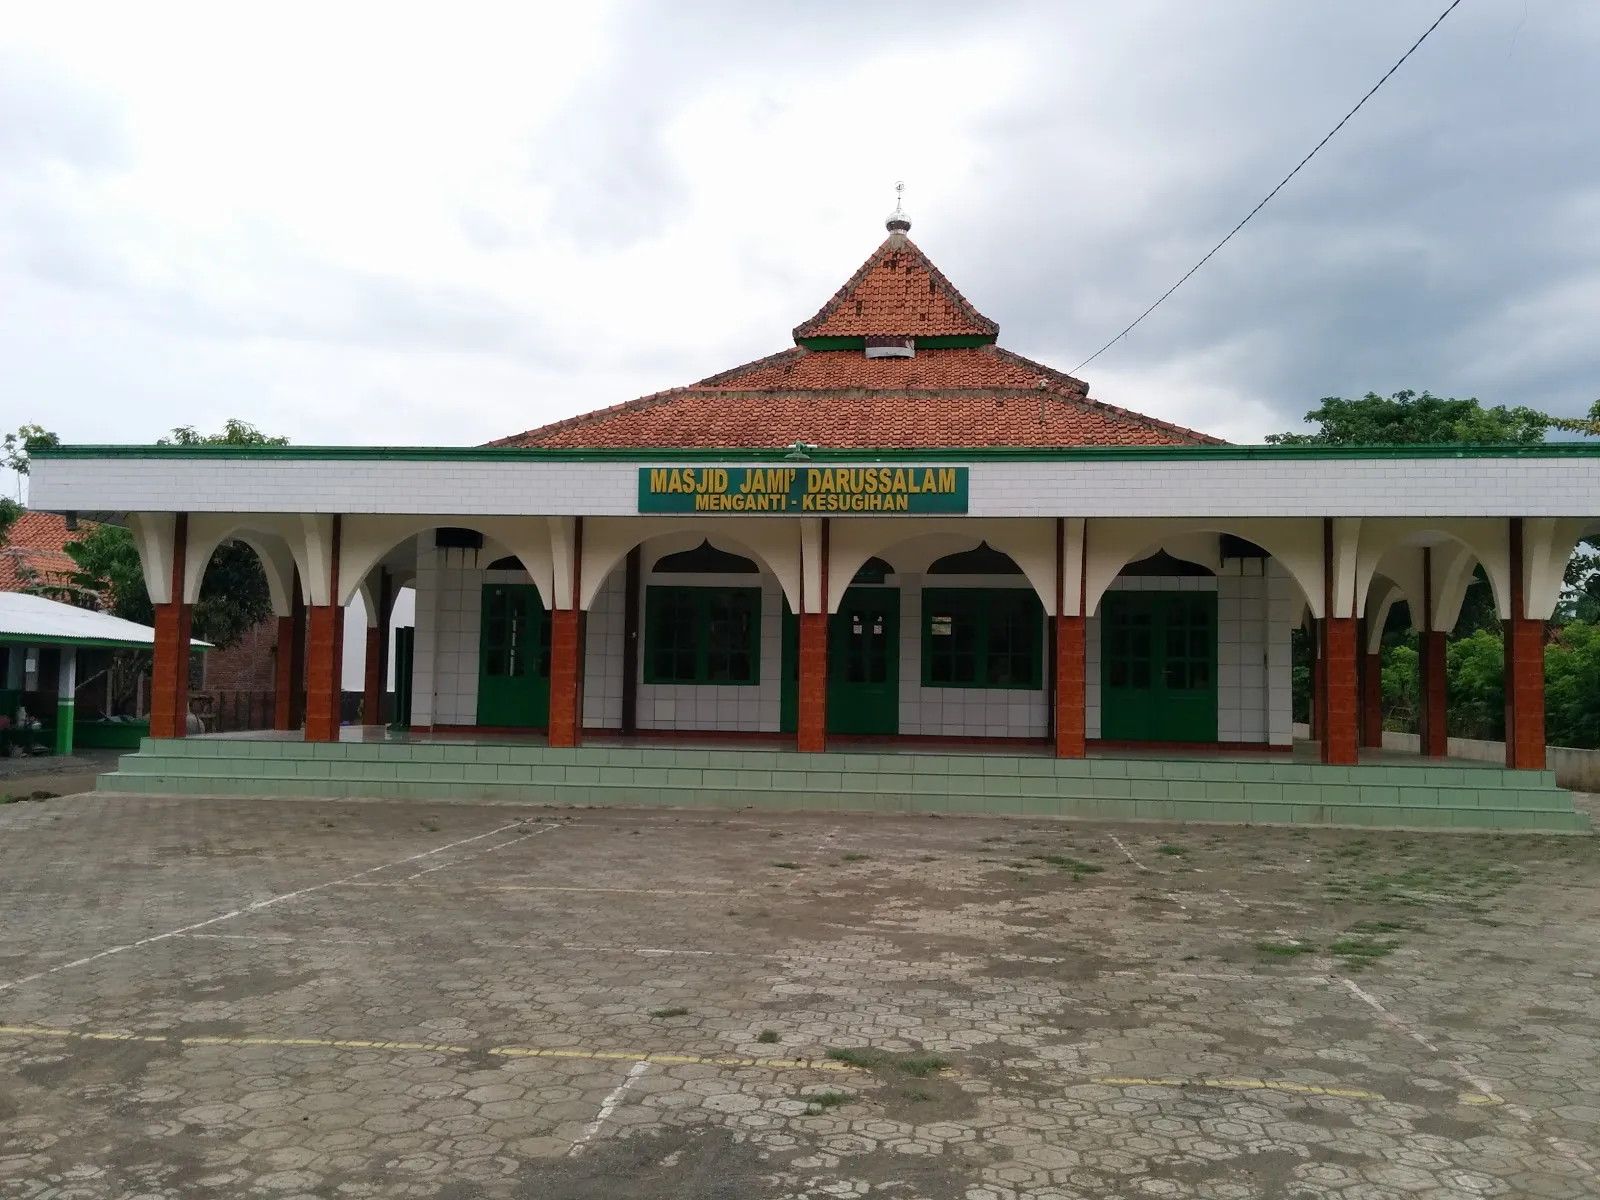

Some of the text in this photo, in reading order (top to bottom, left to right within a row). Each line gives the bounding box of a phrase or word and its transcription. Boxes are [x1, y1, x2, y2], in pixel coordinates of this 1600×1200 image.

[650, 468, 956, 494] MASJID JAMI' DARUSSALAM
[695, 494, 786, 511] MENGANTI
[802, 494, 909, 511] KESUGIHAN
